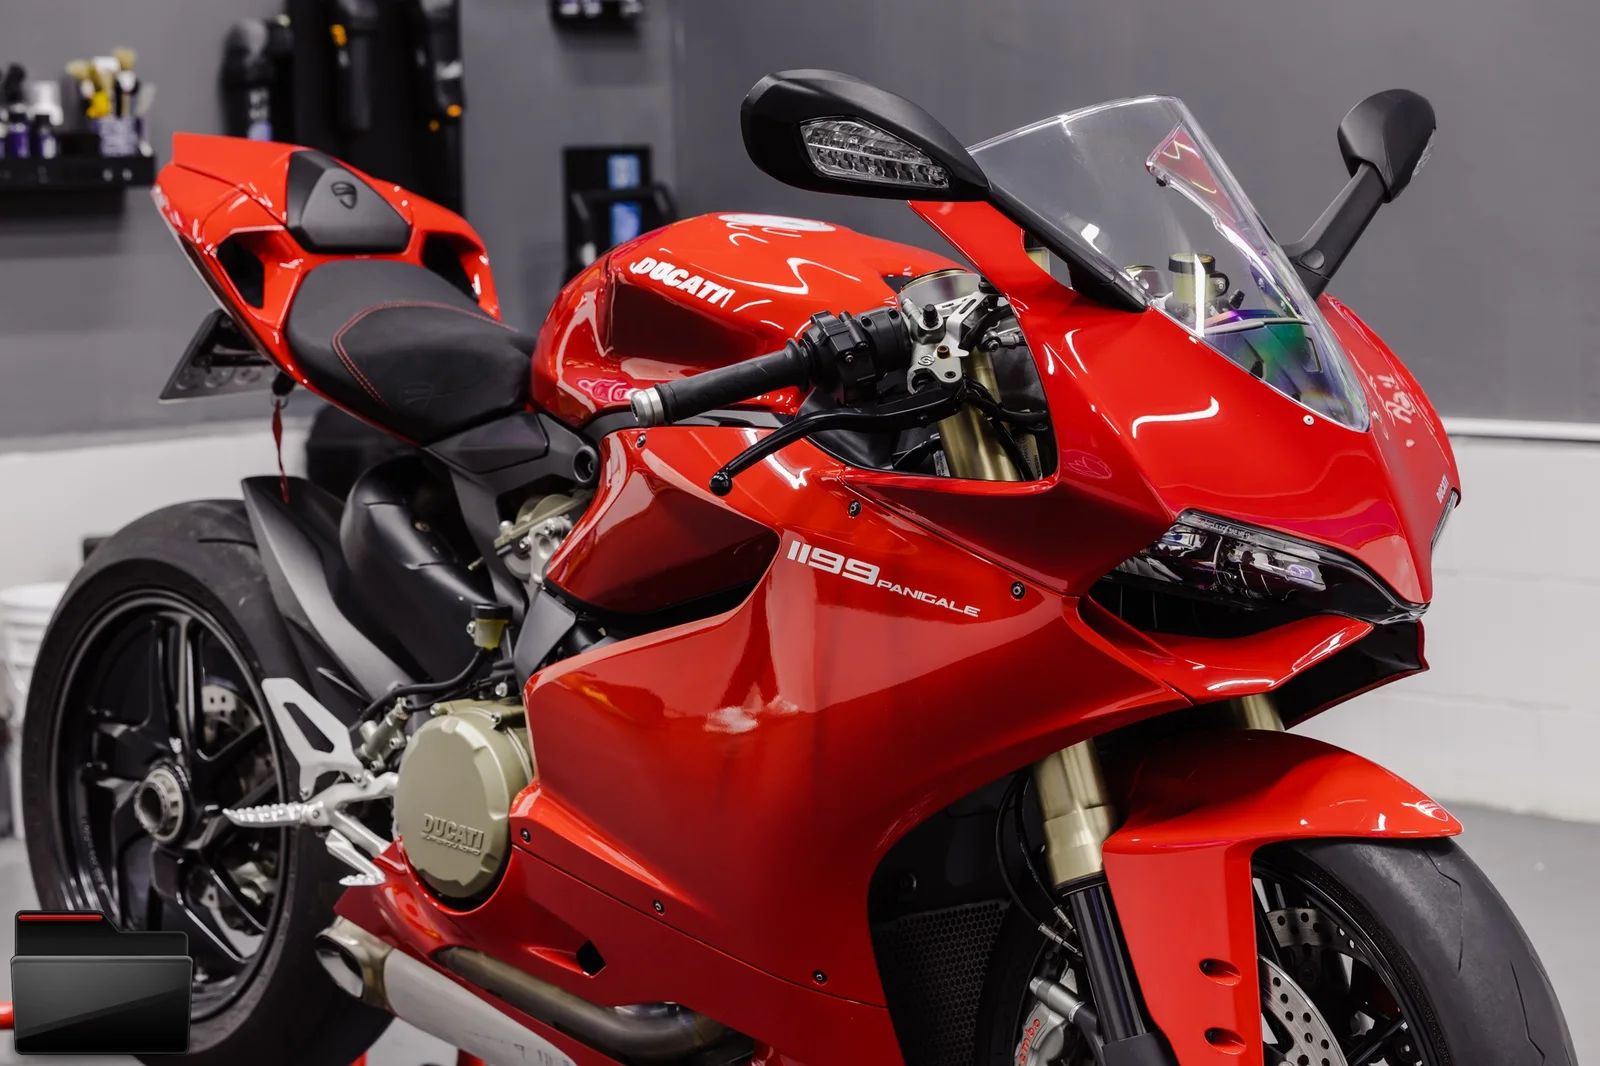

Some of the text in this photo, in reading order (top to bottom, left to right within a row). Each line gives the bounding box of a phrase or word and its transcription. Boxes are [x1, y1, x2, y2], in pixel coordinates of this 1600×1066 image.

[629, 256, 735, 308] DUCATI
[1436, 473, 1450, 504] DUCATI
[787, 540, 981, 618] 1199 PANIGALE
[422, 812, 485, 849] DUCATI
[1017, 1019, 1040, 1066] embo
